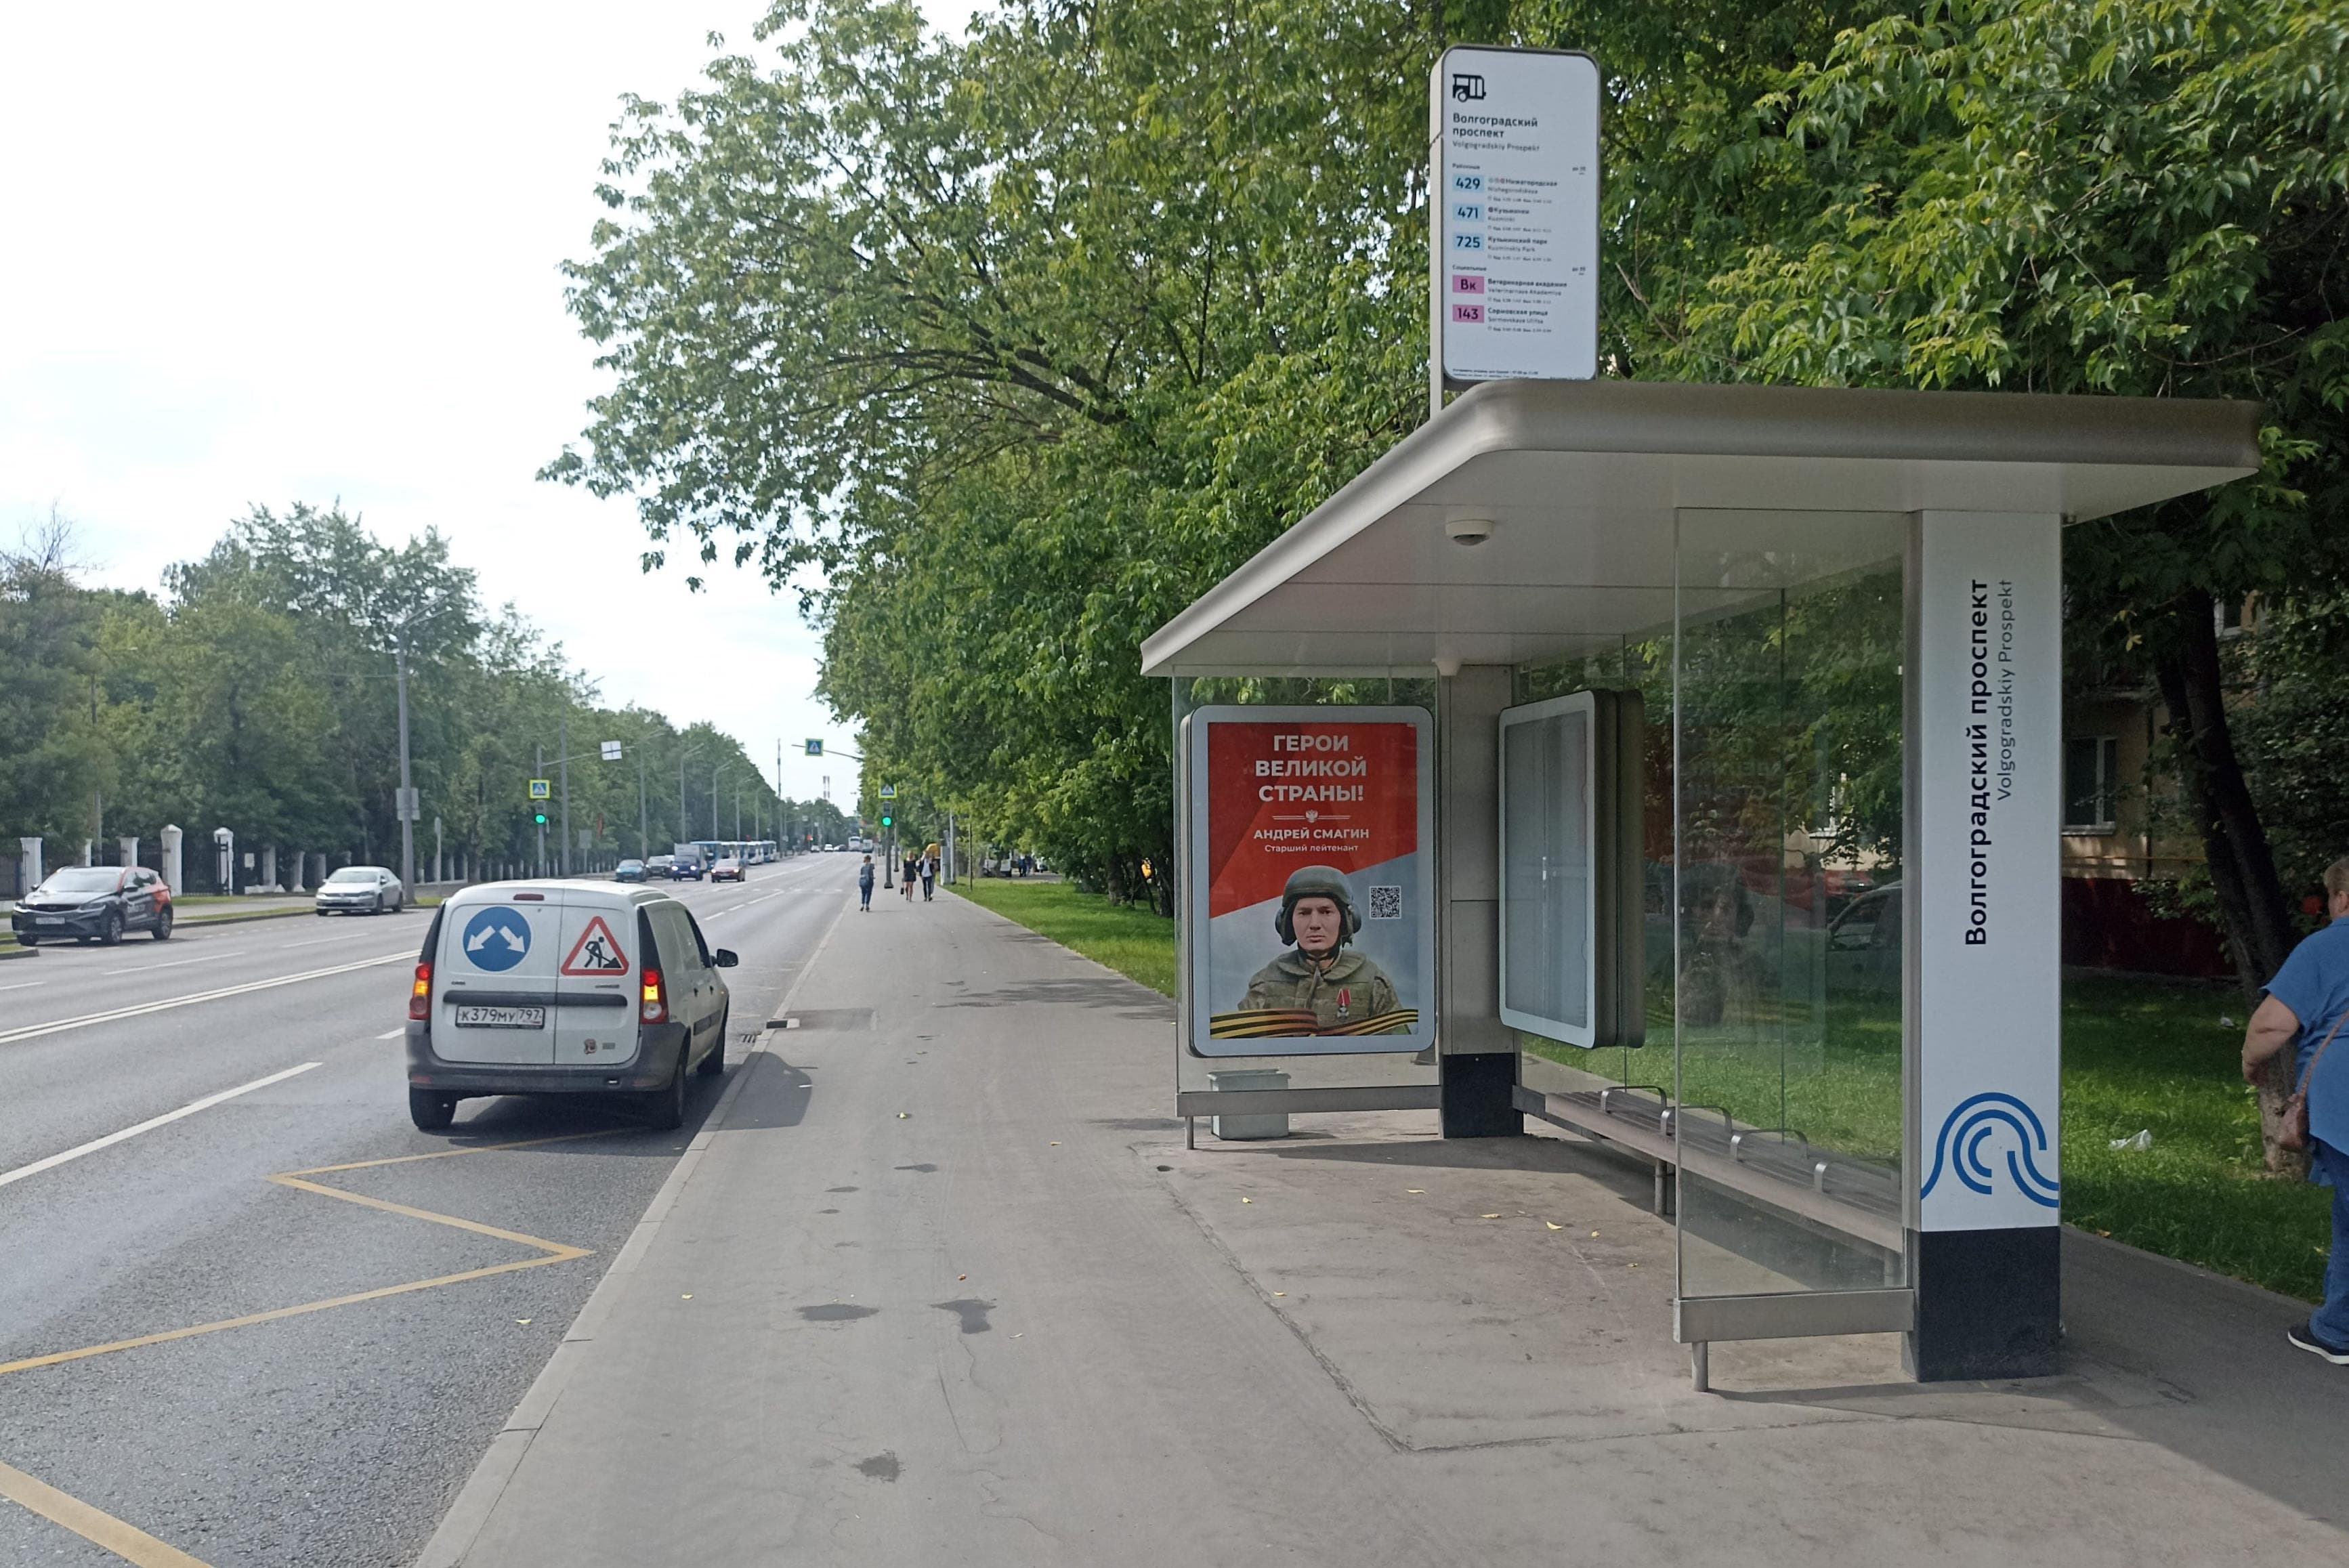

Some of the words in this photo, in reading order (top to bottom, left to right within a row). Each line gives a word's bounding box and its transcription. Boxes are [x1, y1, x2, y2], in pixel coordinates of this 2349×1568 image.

[1453, 112, 1538, 127] Волгоградский
[1452, 127, 1504, 138] проспект
[1456, 177, 1481, 190] 429
[1458, 207, 1479, 219] 471
[1456, 236, 1481, 249] 725
[1460, 278, 1476, 291] Вк
[1458, 308, 1479, 320] 143
[1997, 579, 2016, 662] Prospekt
[1971, 579, 1993, 714] проспект
[1996, 669, 2016, 801] Volgogradskiy
[1273, 735, 1349, 752] ГЕРОИ
[1255, 756, 1366, 777] ВЕЛИКОЙ
[1258, 785, 1363, 803] СТРАНЫ!
[1253, 827, 1310, 841] АНДРЕЙ
[1313, 828, 1369, 839] СМАГИН
[1965, 723, 1992, 945] Волгоградский
[1265, 844, 1307, 853] Старший
[1309, 844, 1359, 853] лейтенант
[518, 1009, 540, 1021] 797
